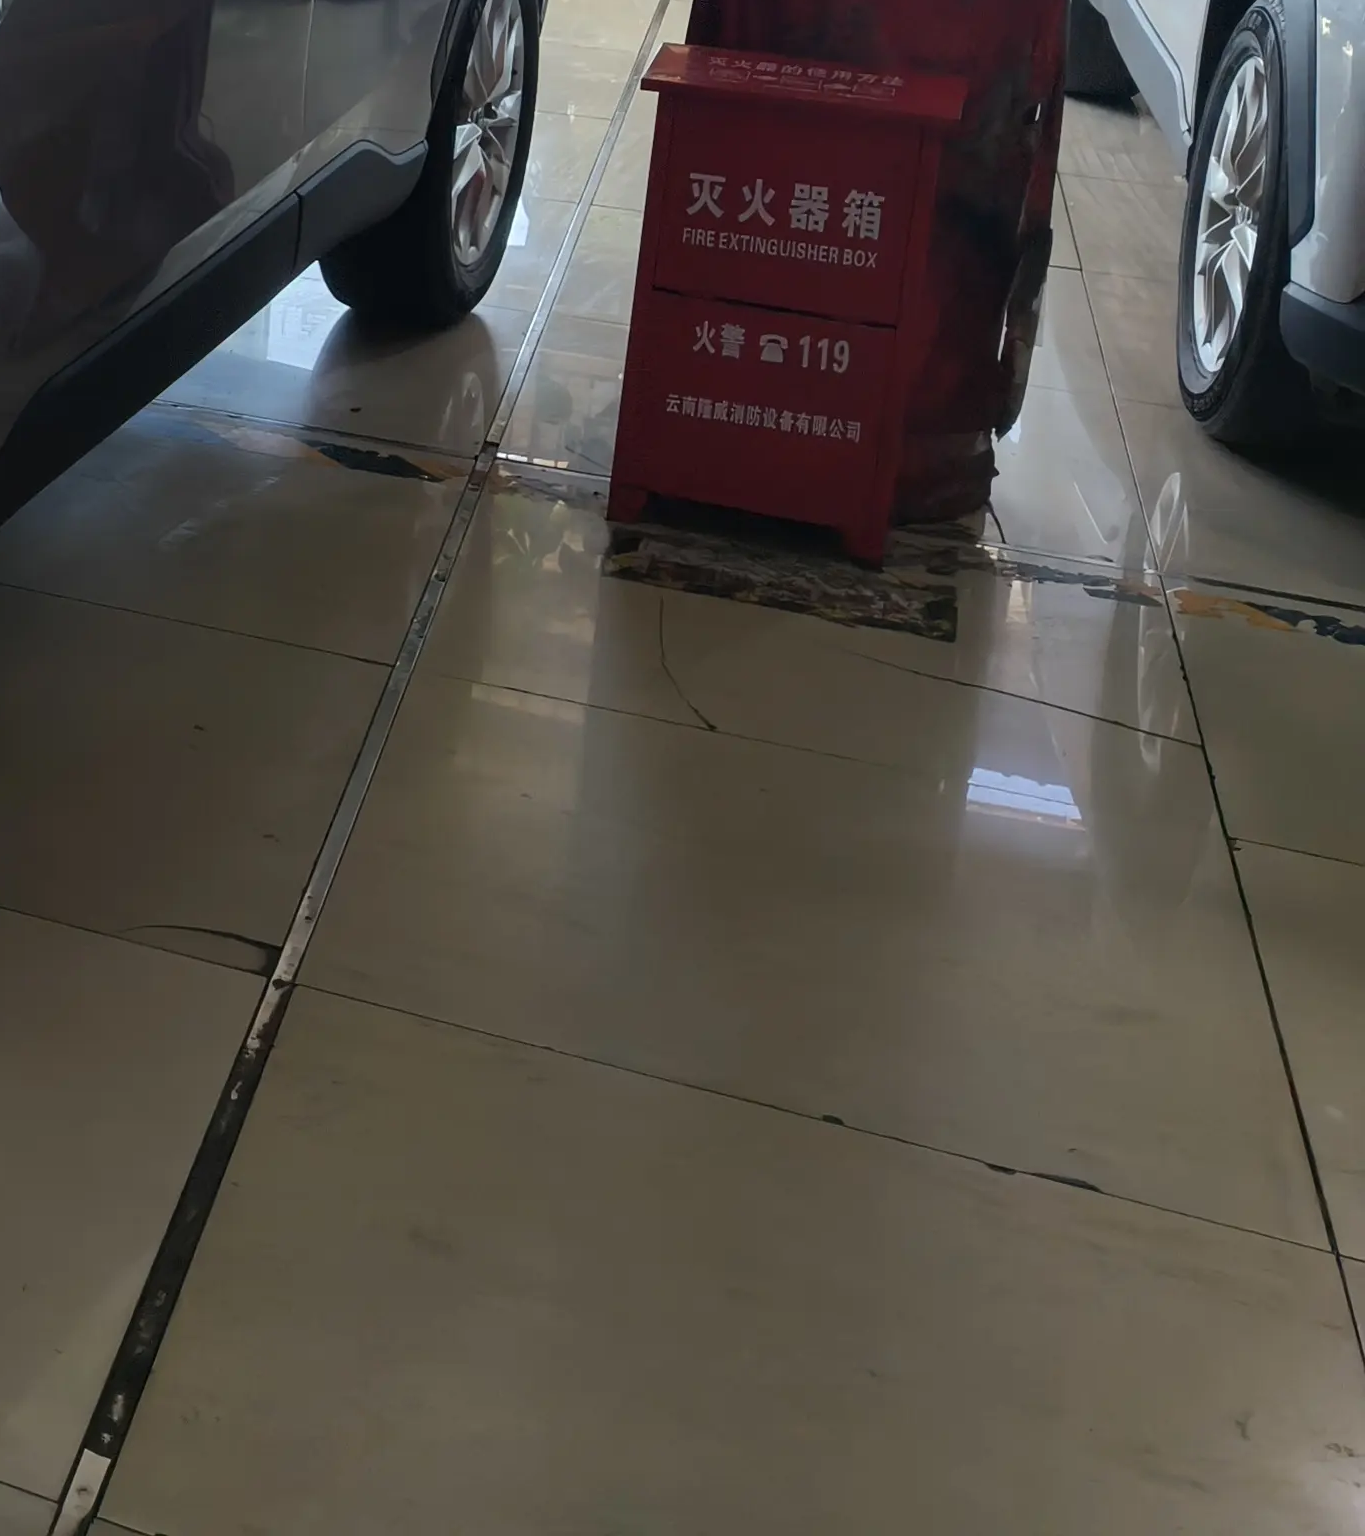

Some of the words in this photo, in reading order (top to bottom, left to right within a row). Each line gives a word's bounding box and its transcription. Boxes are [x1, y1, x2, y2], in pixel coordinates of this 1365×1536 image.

[686, 172, 885, 240] 灭火器箱
[682, 227, 716, 248] FIRE
[719, 232, 839, 264] EXTINGUISHER
[842, 249, 878, 268] BOX
[693, 320, 746, 359] 火警
[799, 335, 850, 373] 119
